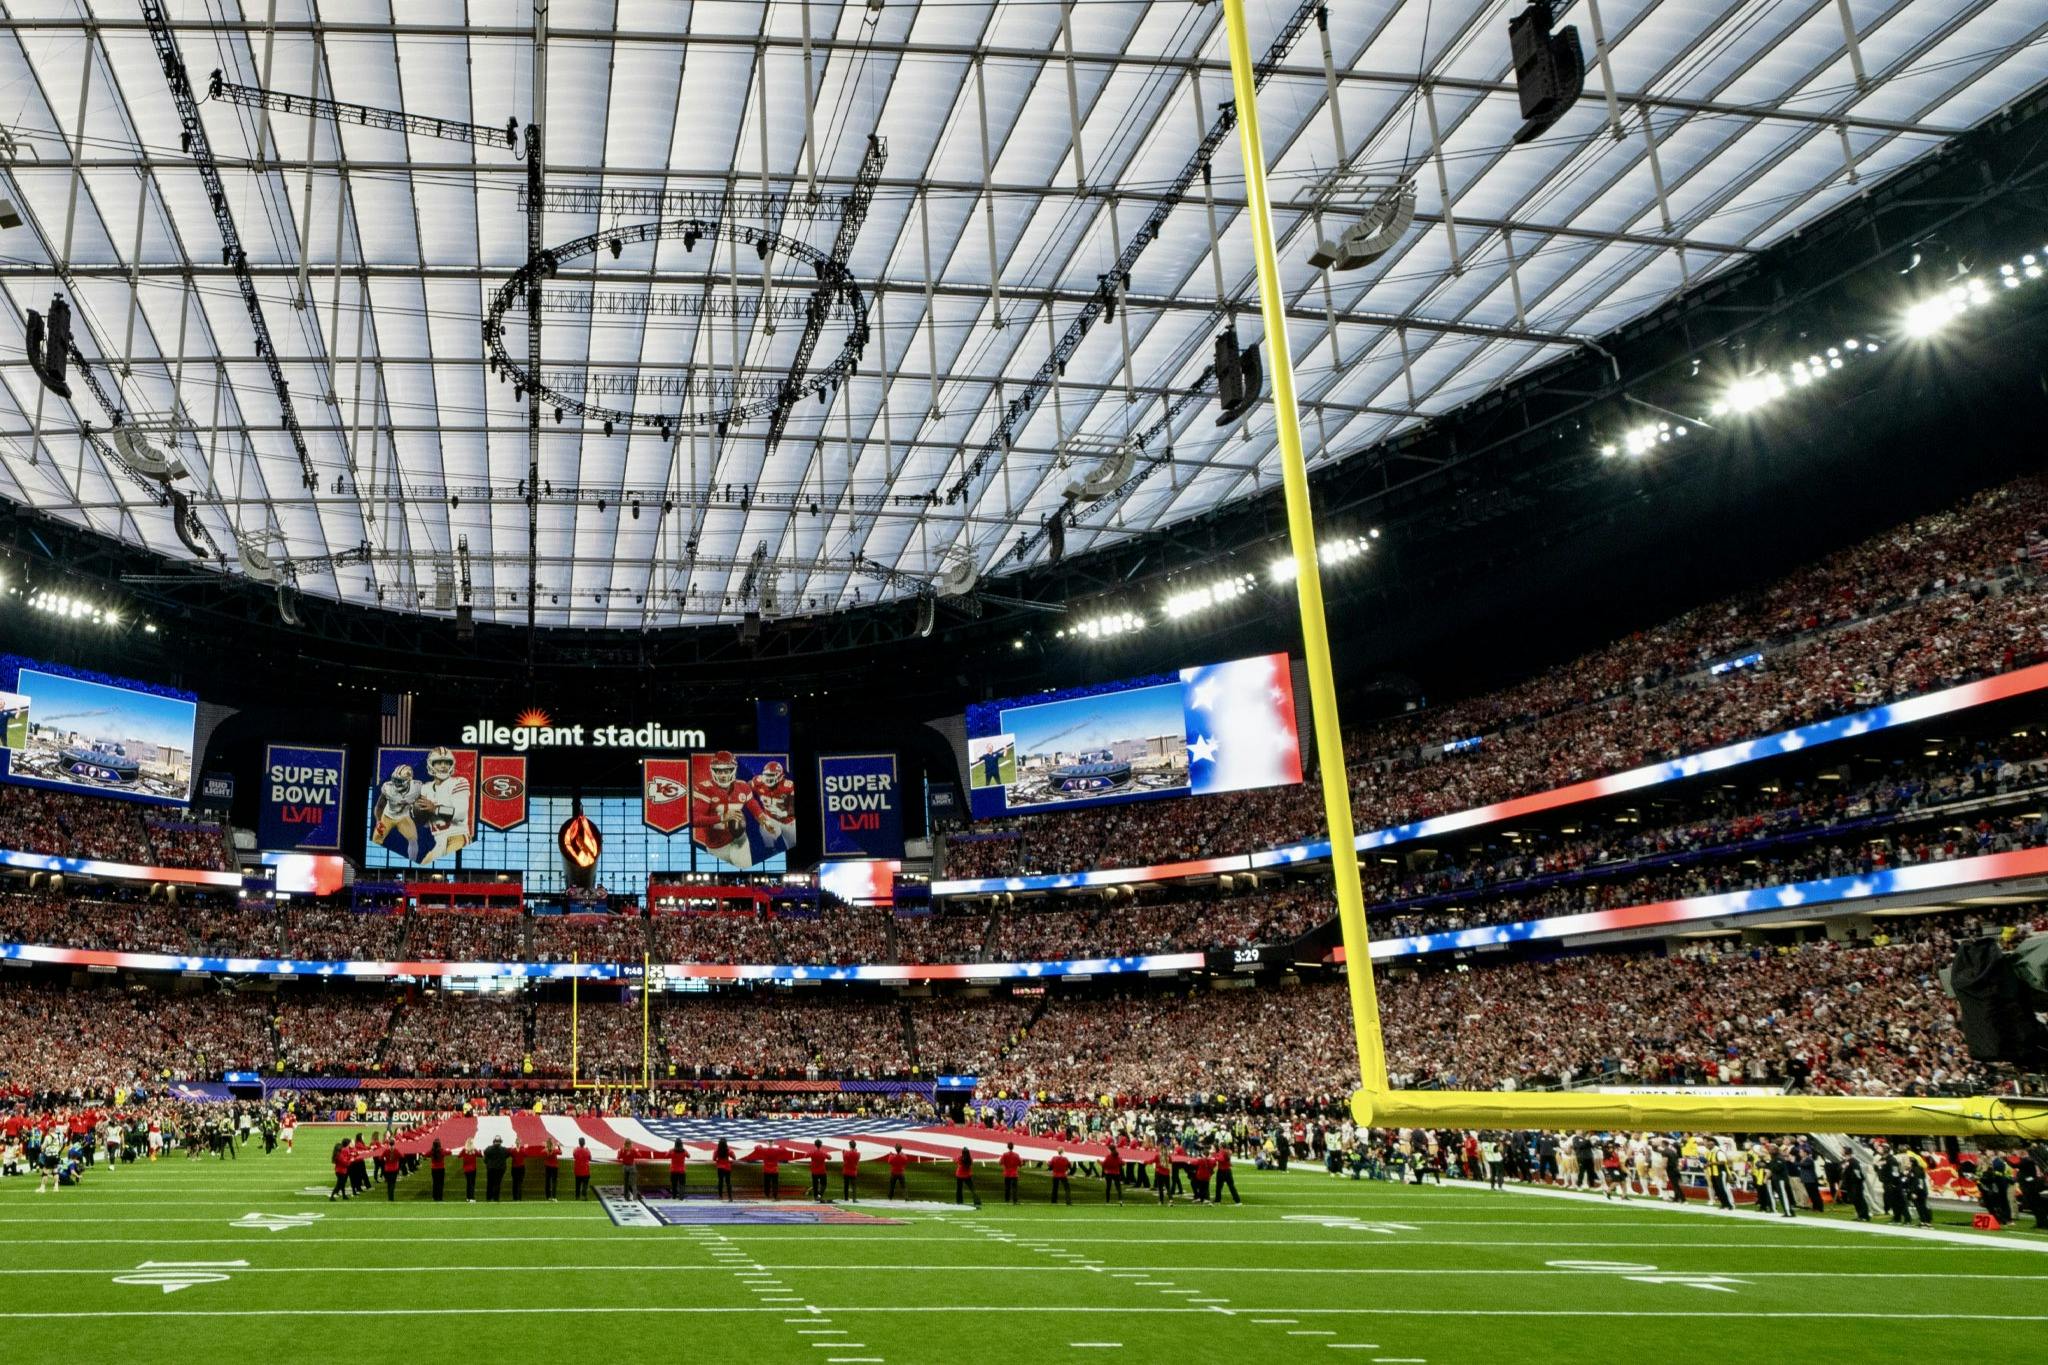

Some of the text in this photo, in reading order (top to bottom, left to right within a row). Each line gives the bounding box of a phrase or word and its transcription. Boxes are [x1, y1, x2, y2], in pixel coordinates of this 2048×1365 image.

[461, 720, 706, 751] allegiant stadium
[208, 780, 228, 788] BUD
[271, 765, 338, 785] SUPER
[825, 774, 891, 792] SUPER
[204, 787, 230, 796] LIGHT
[272, 785, 336, 805] BOWL
[828, 794, 892, 812] BOWL
[282, 805, 323, 823] LVIII
[840, 813, 880, 831] LVIII
[1234, 949, 1259, 962] 3:29
[350, 1111, 387, 1122] SPER
[1975, 1215, 1991, 1229] 20
